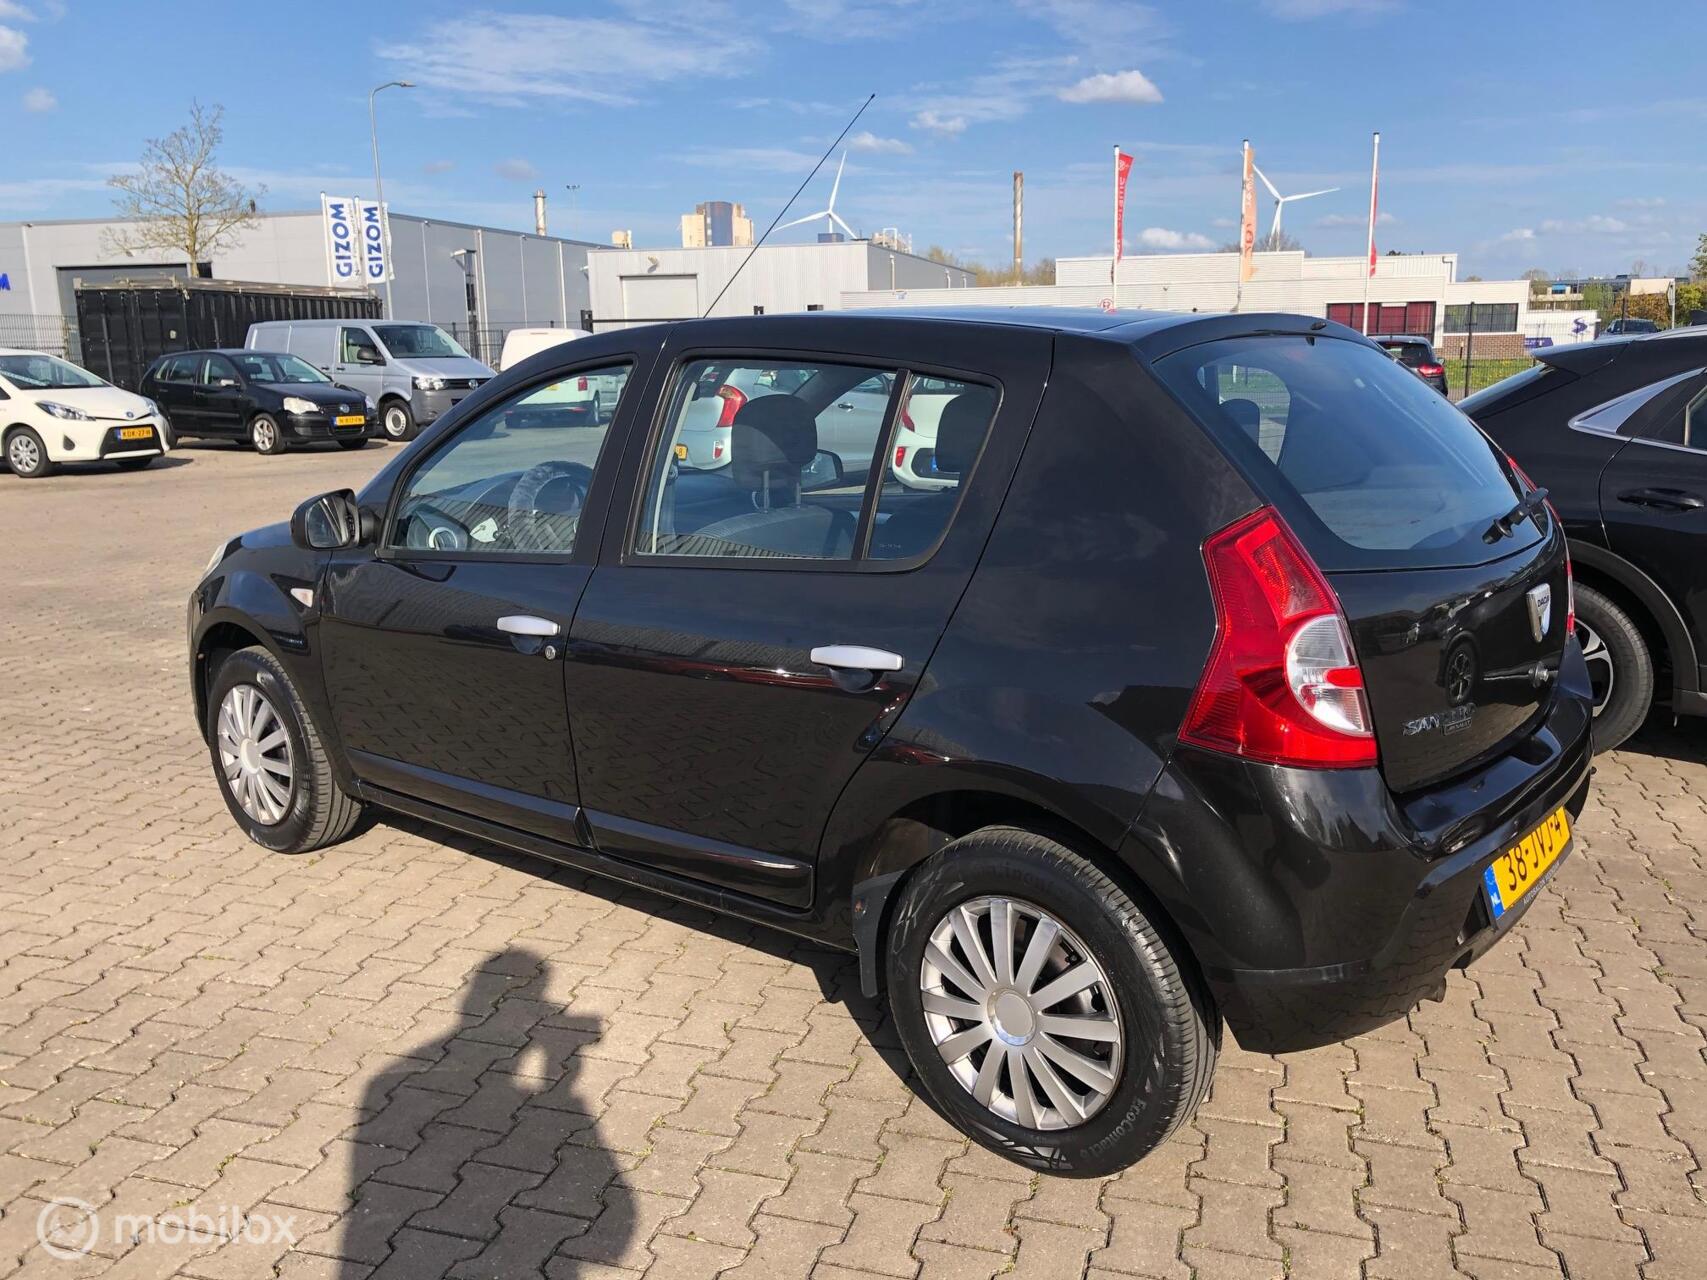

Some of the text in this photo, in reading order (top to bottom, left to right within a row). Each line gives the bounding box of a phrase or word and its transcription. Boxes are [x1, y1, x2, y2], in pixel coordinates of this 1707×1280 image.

[330, 204, 352, 277] GIZOM
[363, 206, 383, 278] GIZOM
[1502, 812, 1562, 892] 38-JVJ-4
